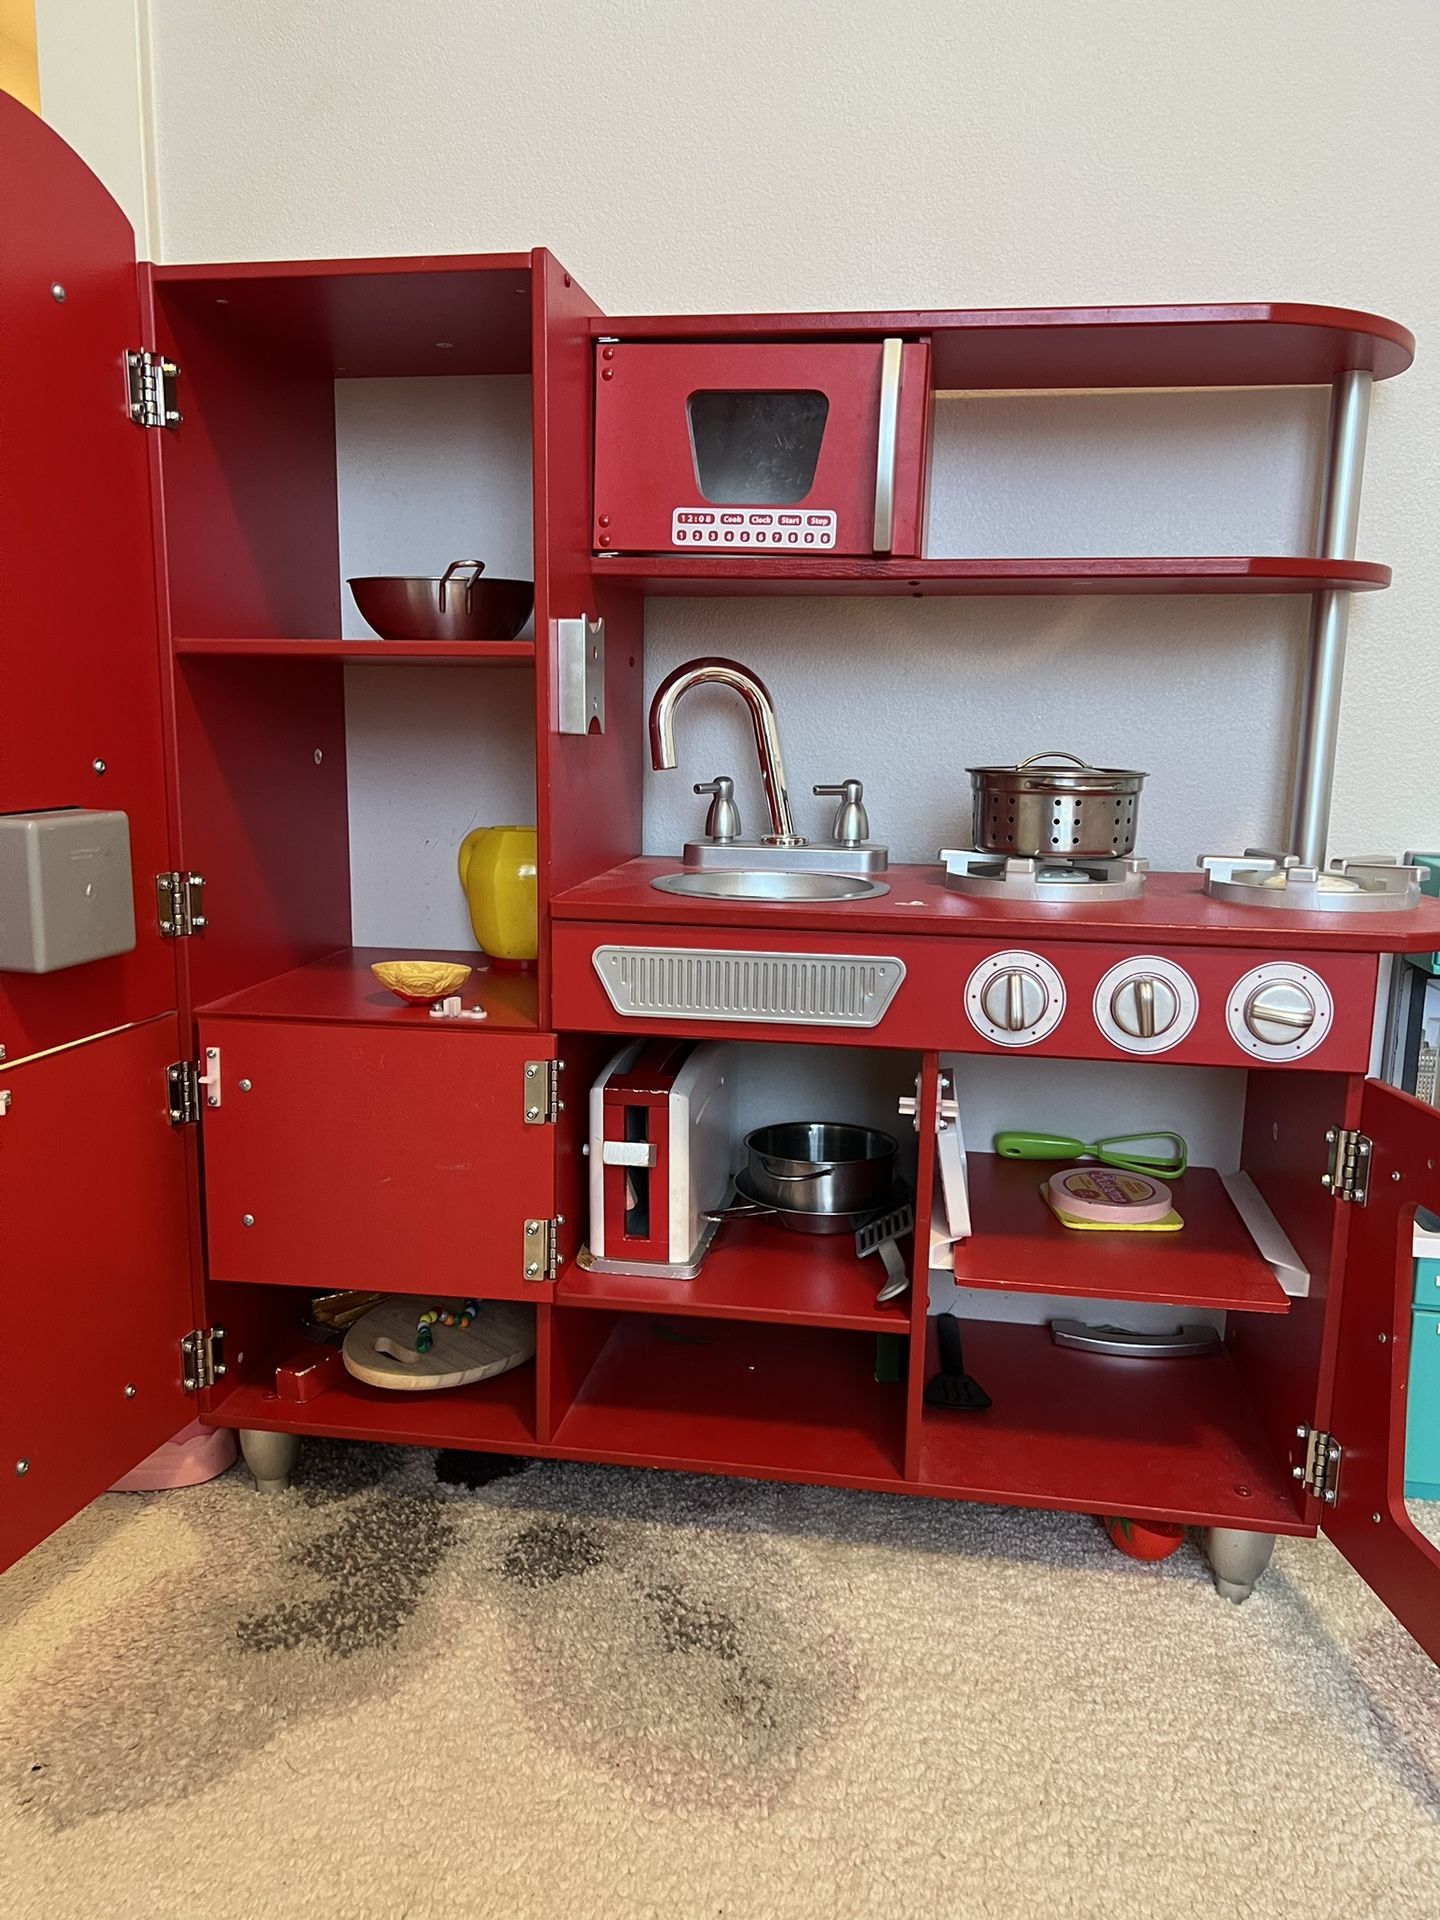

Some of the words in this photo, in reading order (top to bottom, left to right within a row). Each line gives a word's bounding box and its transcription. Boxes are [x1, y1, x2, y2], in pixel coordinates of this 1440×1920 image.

[681, 515, 711, 523] 12:08
[723, 515, 742, 523] Cook
[751, 516, 771, 524] Clock
[781, 516, 800, 524] Start
[810, 517, 828, 526] Stop
